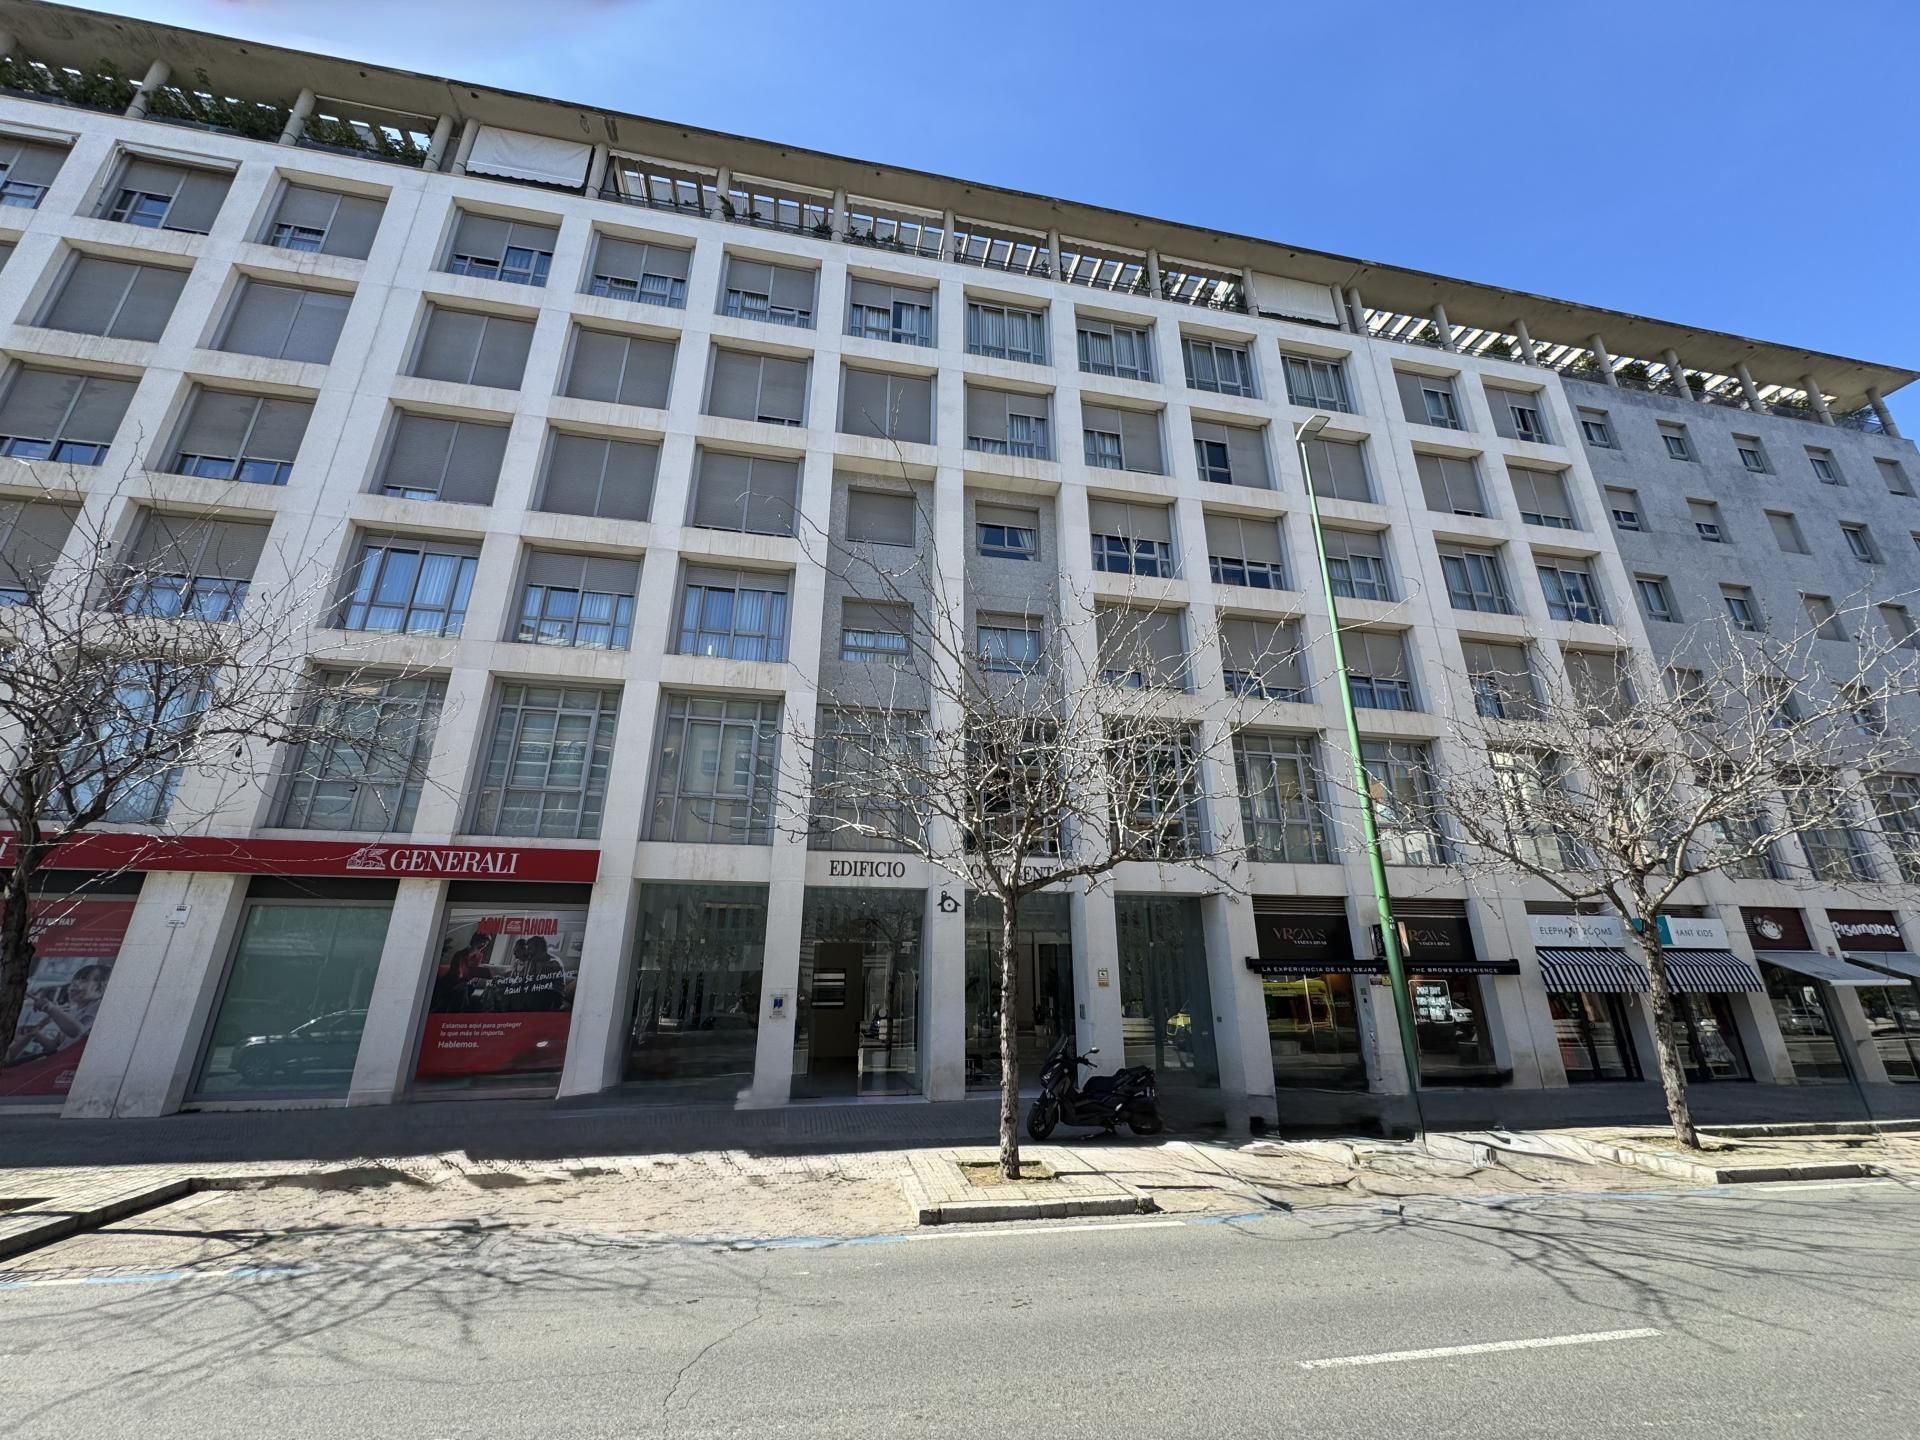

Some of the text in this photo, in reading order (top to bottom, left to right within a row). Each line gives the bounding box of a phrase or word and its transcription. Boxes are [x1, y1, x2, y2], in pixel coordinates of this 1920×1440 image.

[390, 849, 520, 874] GENERALI
[829, 860, 905, 878] EDIFICIO
[524, 918, 558, 935] AHORA
[1539, 926, 1578, 936] ELEPHANT
[1696, 929, 1714, 938] KIDS
[531, 982, 553, 992] AHORA
[496, 1022, 522, 1030] proteger
[437, 1041, 480, 1049] Hablemos.
